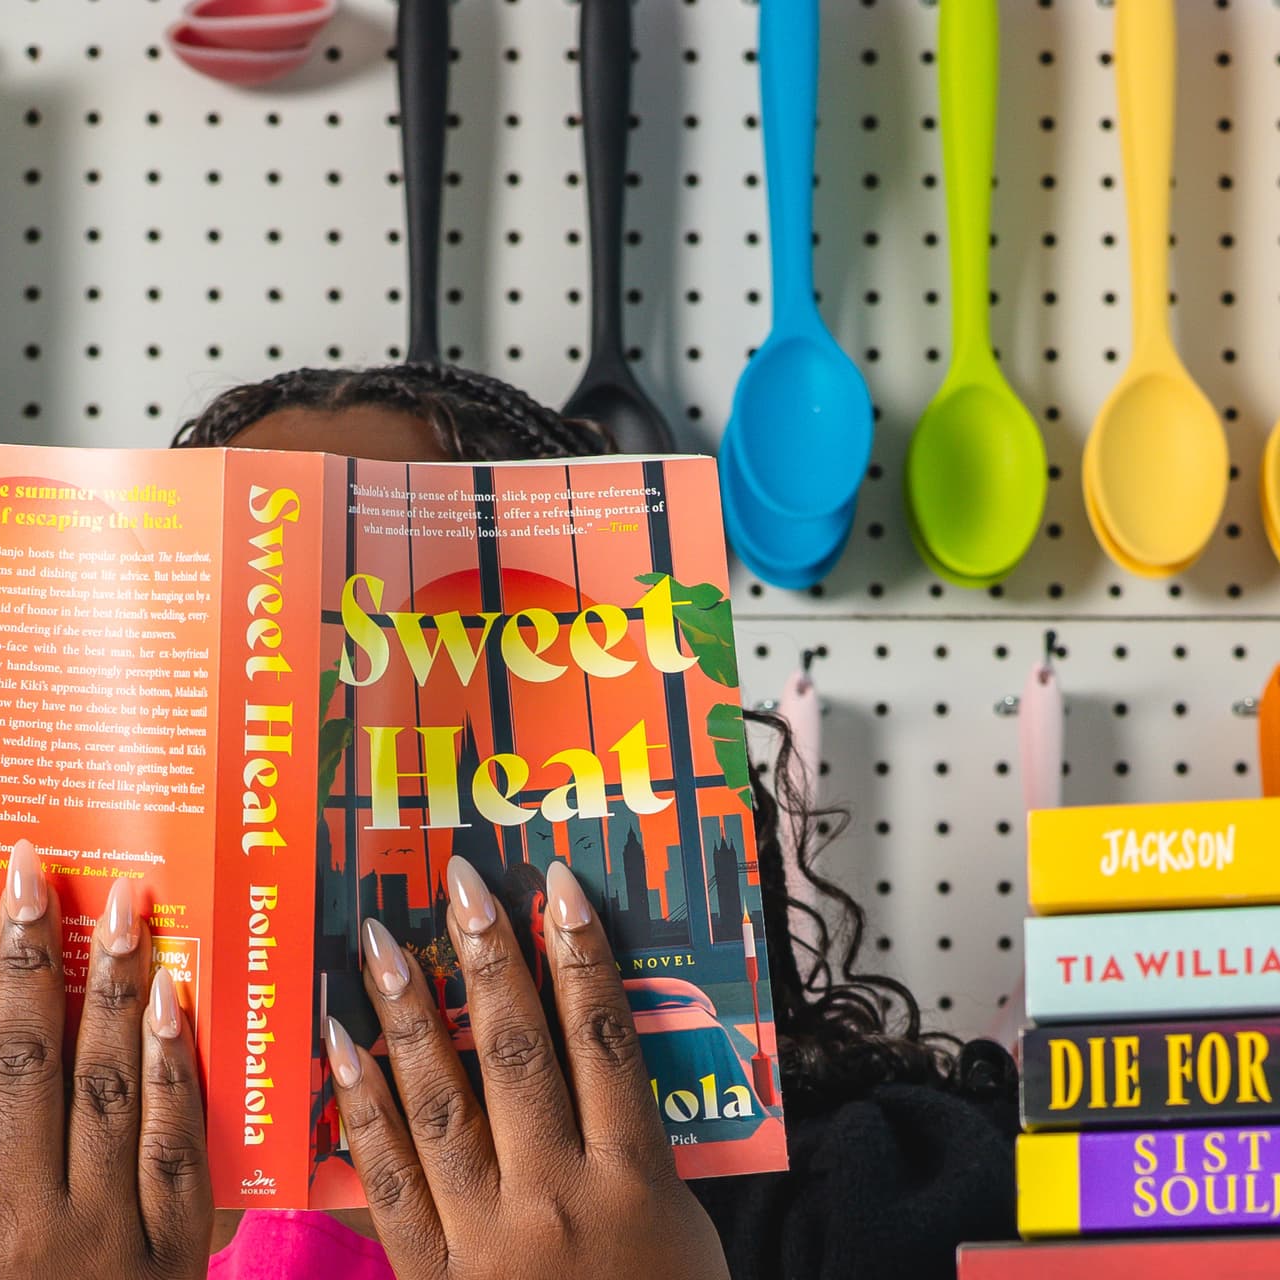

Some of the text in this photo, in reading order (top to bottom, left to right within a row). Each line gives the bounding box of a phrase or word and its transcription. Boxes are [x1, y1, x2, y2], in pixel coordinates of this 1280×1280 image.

[15, 482, 96, 500] summer
[104, 484, 181, 506] wedding.
[390, 488, 416, 503] sharp
[418, 490, 446, 501] sense
[447, 489, 458, 501] of
[460, 491, 499, 503] humor,
[502, 489, 527, 502] slick
[531, 490, 551, 505] pop
[555, 488, 595, 501] culture
[598, 486, 661, 500] references,
[15, 512, 104, 533] escaping
[109, 512, 138, 529] the
[144, 512, 183, 529] heat.
[349, 500, 664, 523] and keen sense of the zeitgeist offer a refreshing portrait of
[363, 524, 383, 535] what
[385, 525, 420, 536] modern
[422, 525, 443, 537] love
[446, 525, 475, 540] really
[478, 525, 507, 538] looks
[510, 524, 530, 537] and
[533, 524, 560, 536] feels
[339, 572, 701, 689] Sweet
[363, 719, 675, 830] Heat
[241, 484, 301, 1146] Sweet Heat Bolu Babalola
[1100, 824, 1236, 877] JACKSON
[633, 954, 696, 970] NOVEL
[1057, 955, 1125, 985] TIA
[1047, 1035, 1142, 1112] DIE
[1164, 1030, 1272, 1107] FOR
[670, 1133, 699, 1146] Pick
